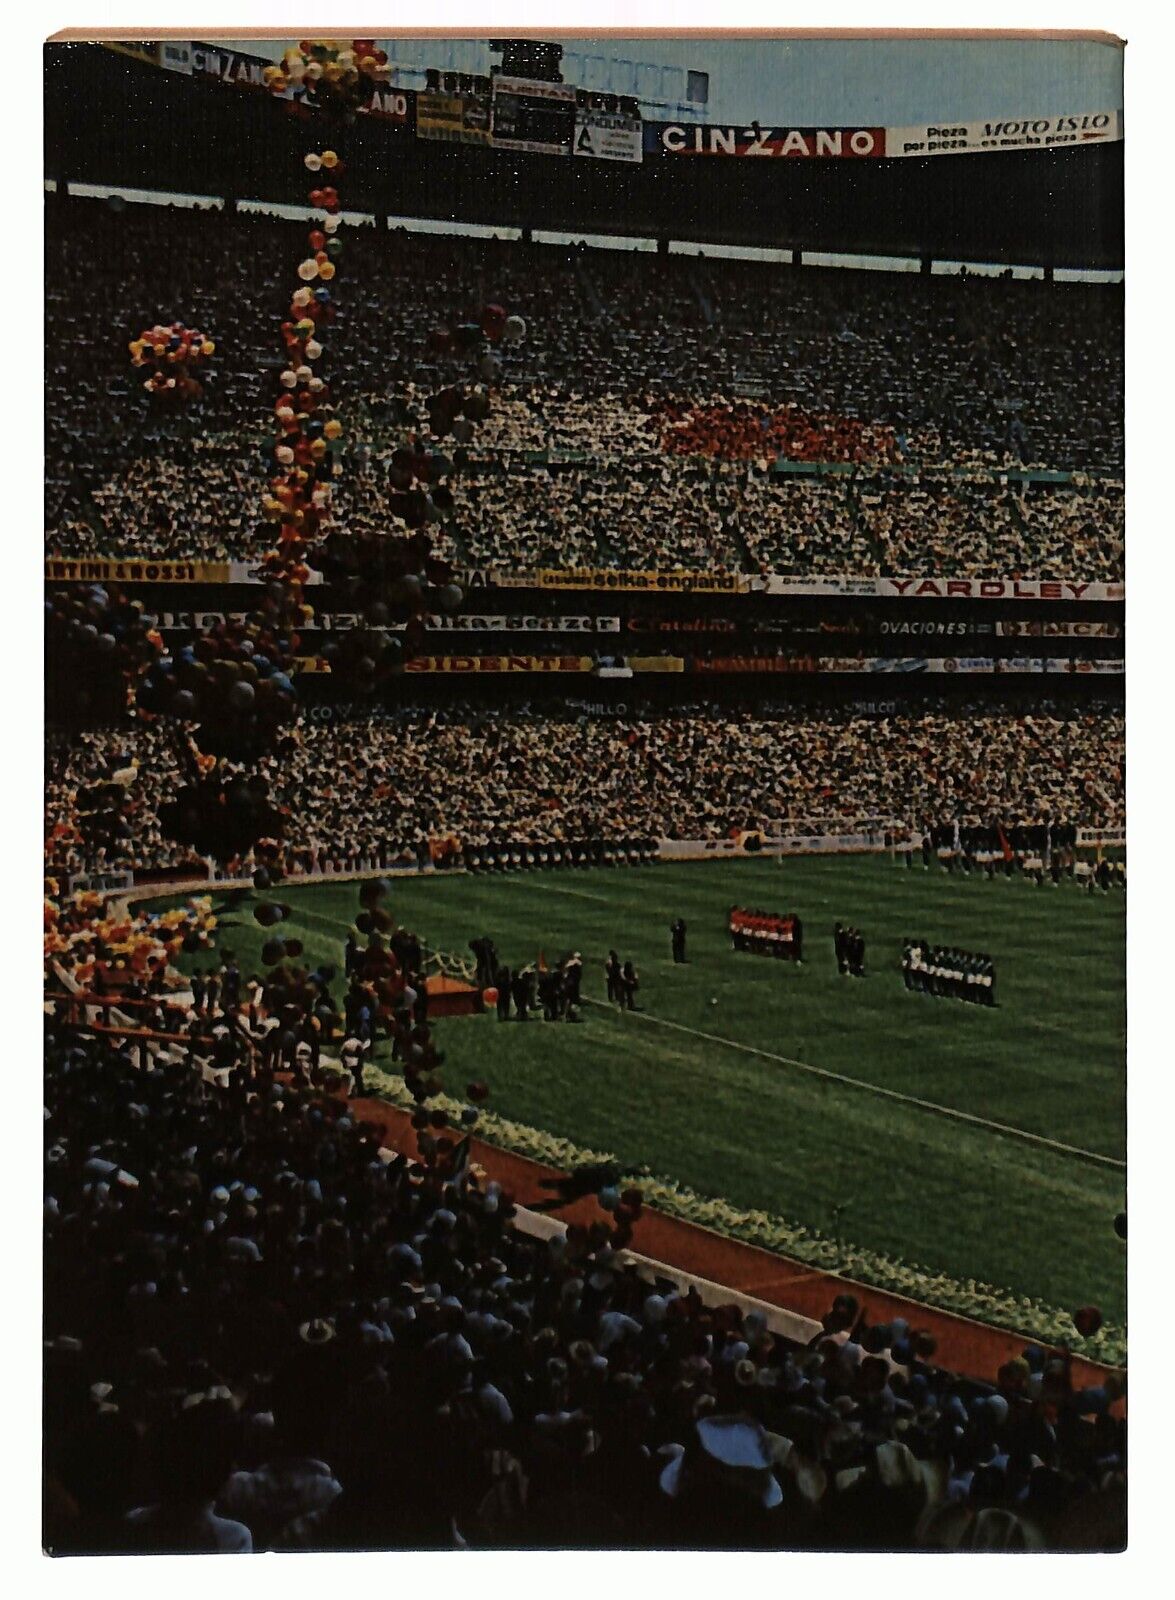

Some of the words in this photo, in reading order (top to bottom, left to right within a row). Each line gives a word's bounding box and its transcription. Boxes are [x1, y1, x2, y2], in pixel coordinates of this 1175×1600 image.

[927, 127, 968, 138] Pieza
[983, 120, 1050, 137] MOTO
[662, 126, 875, 156] CINZANO
[131, 564, 195, 580] ROSSI
[890, 580, 1090, 598] YARDLEY
[880, 621, 967, 635] OVACIONES
